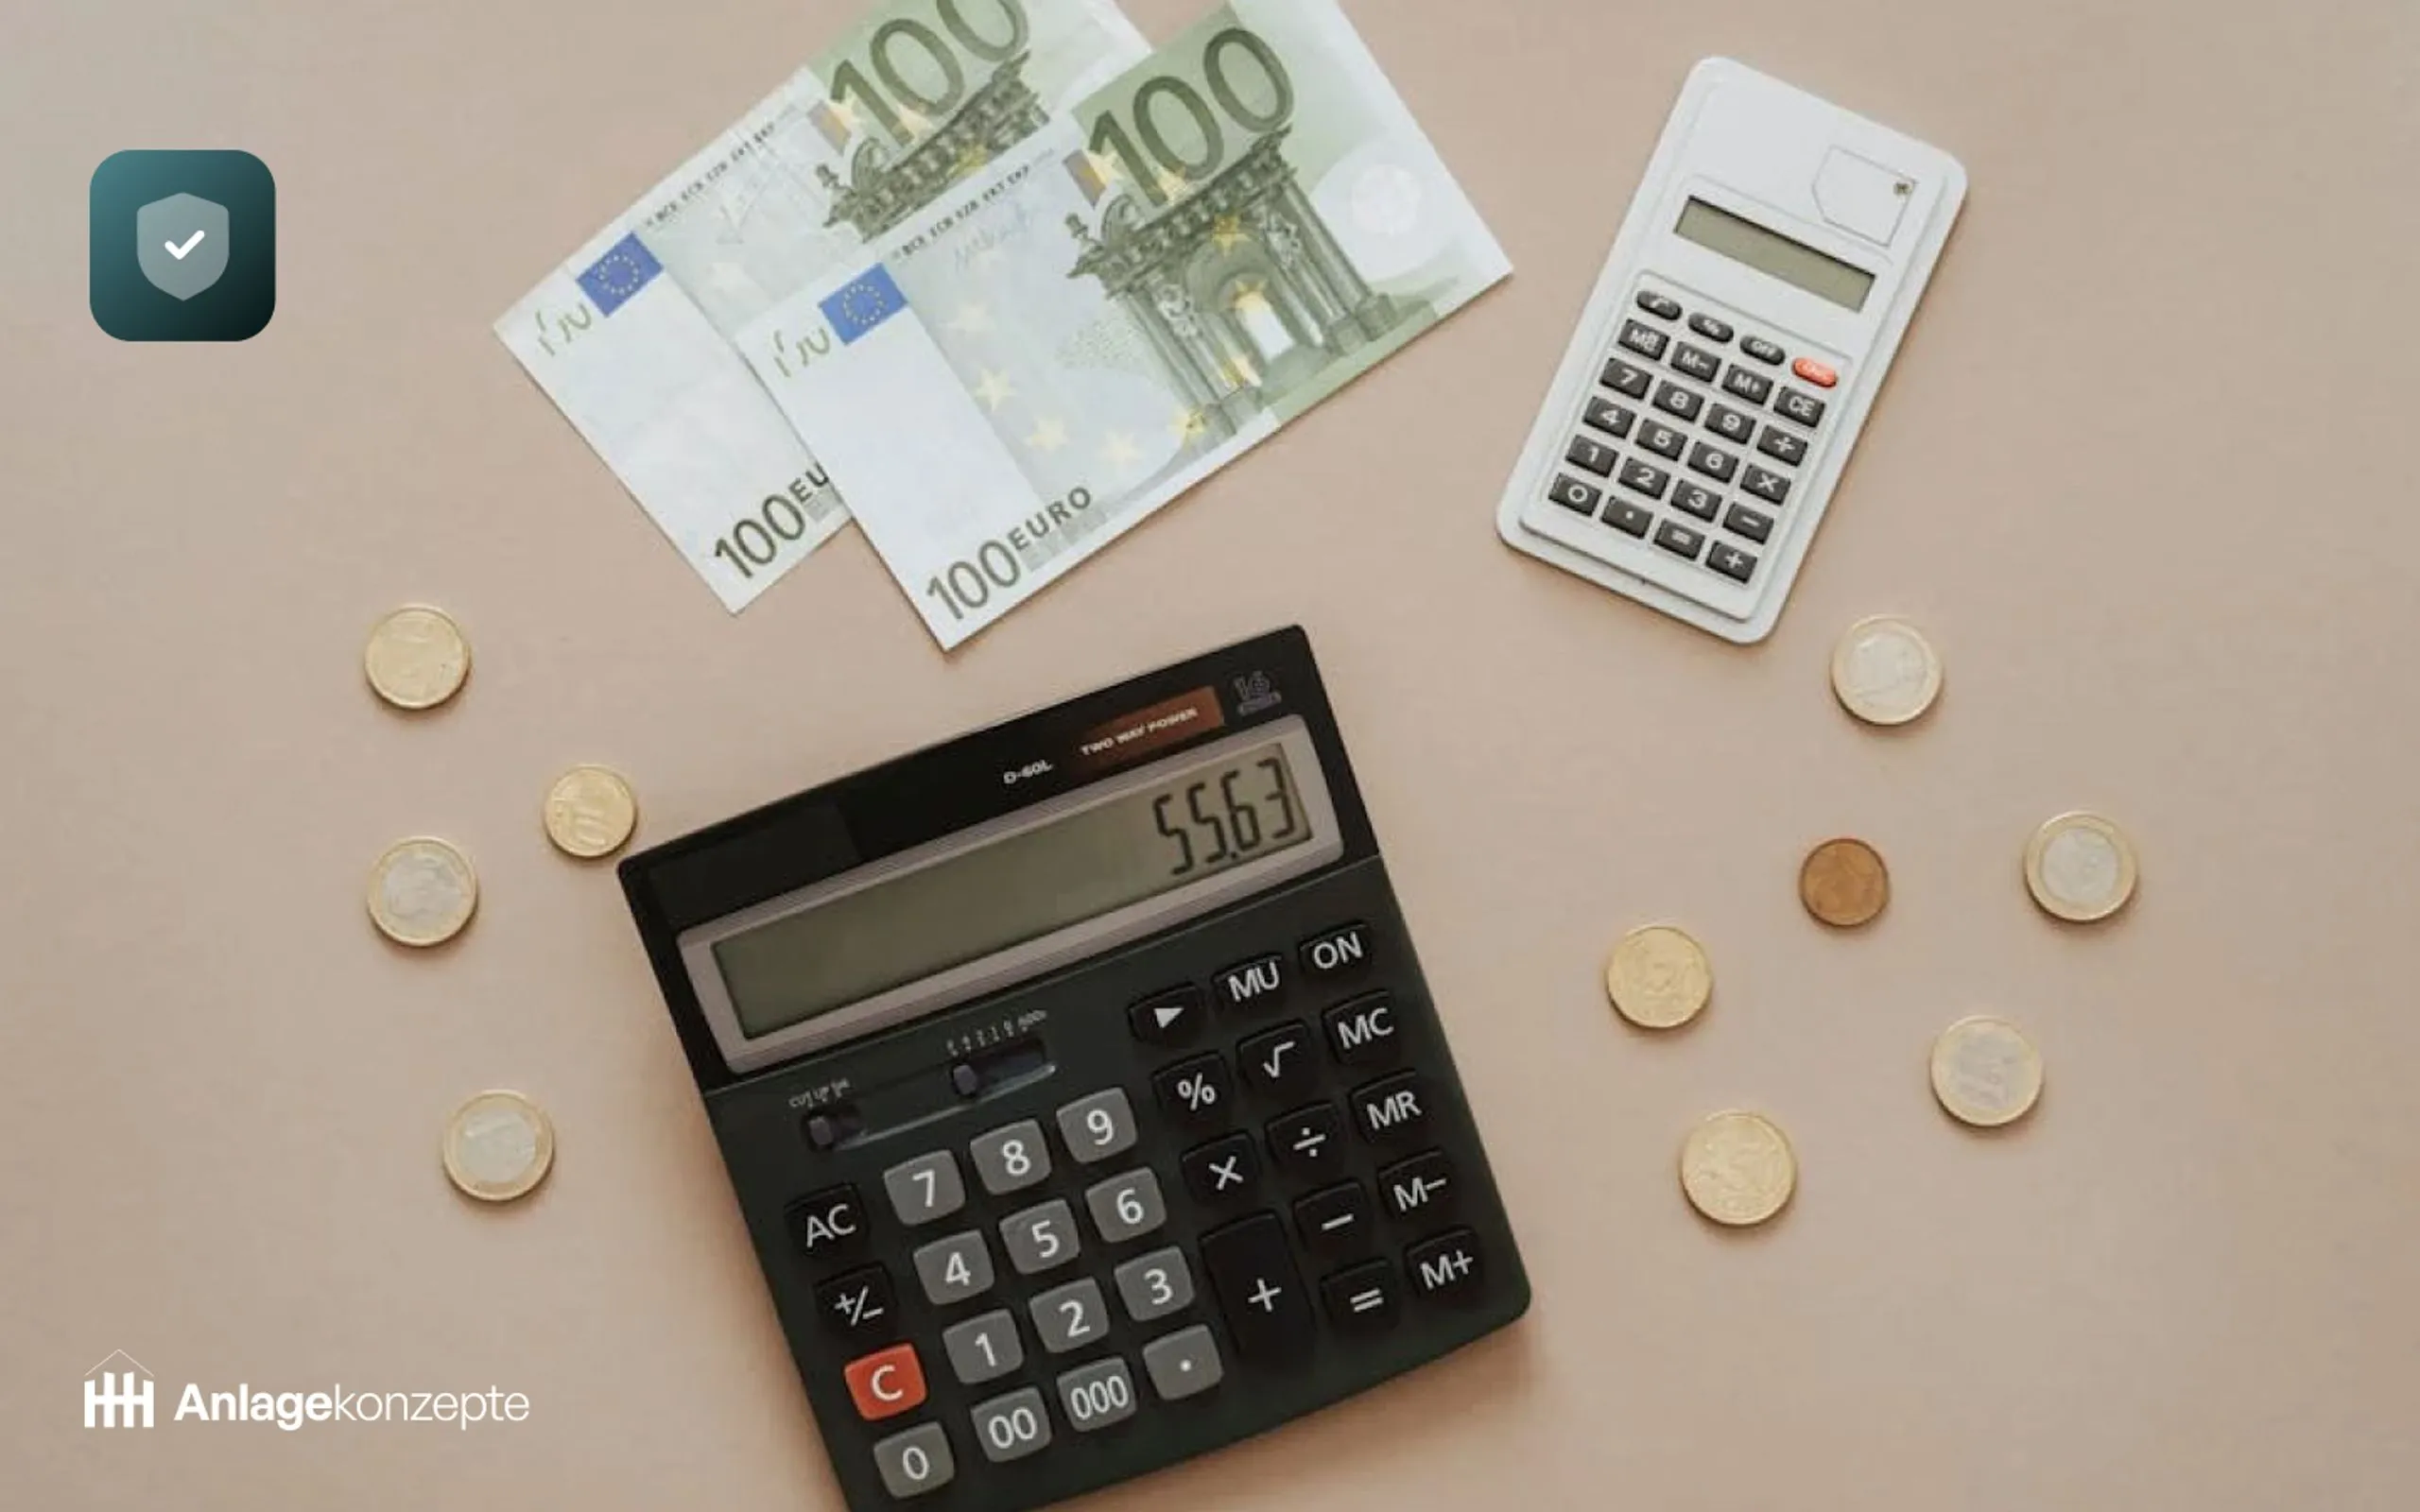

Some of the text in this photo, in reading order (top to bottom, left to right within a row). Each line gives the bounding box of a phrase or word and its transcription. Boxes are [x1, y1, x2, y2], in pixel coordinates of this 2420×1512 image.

[830, 0, 1028, 146] 100
[1089, 27, 1294, 208] 100
[1622, 369, 1640, 386] 7
[1601, 410, 1619, 425] 4
[1668, 392, 1686, 409] 8
[1654, 430, 1671, 447] 5
[1722, 414, 1740, 431] 9
[1587, 440, 1600, 462] 1
[1707, 453, 1723, 469] 6
[1568, 488, 1587, 502] 0
[1634, 470, 1655, 487] 2
[1687, 490, 1706, 507] 3
[716, 494, 805, 578] 100
[926, 487, 1090, 620] 100 EURO
[1081, 708, 1199, 756] TWO WAY POWER
[1313, 931, 1362, 970] ON
[1228, 962, 1279, 1003] MU
[1337, 1006, 1394, 1049] MC
[1178, 1072, 1215, 1111] %
[1086, 1109, 1114, 1145] 9
[1367, 1091, 1421, 1130] MR
[1002, 1140, 1030, 1176] 8
[912, 1169, 937, 1207] 7
[1116, 1189, 1143, 1225] 6
[805, 1204, 856, 1248] AC
[1032, 1220, 1060, 1258] 5
[945, 1252, 971, 1286] 4
[1143, 1269, 1173, 1304] 3
[1421, 1249, 1474, 1290] M+
[1059, 1300, 1090, 1336] 2
[975, 1332, 997, 1367] 1
[871, 1365, 904, 1400] C
[1070, 1375, 1130, 1419] 000
[989, 1407, 1037, 1449] 00
[902, 1447, 929, 1480] 0
